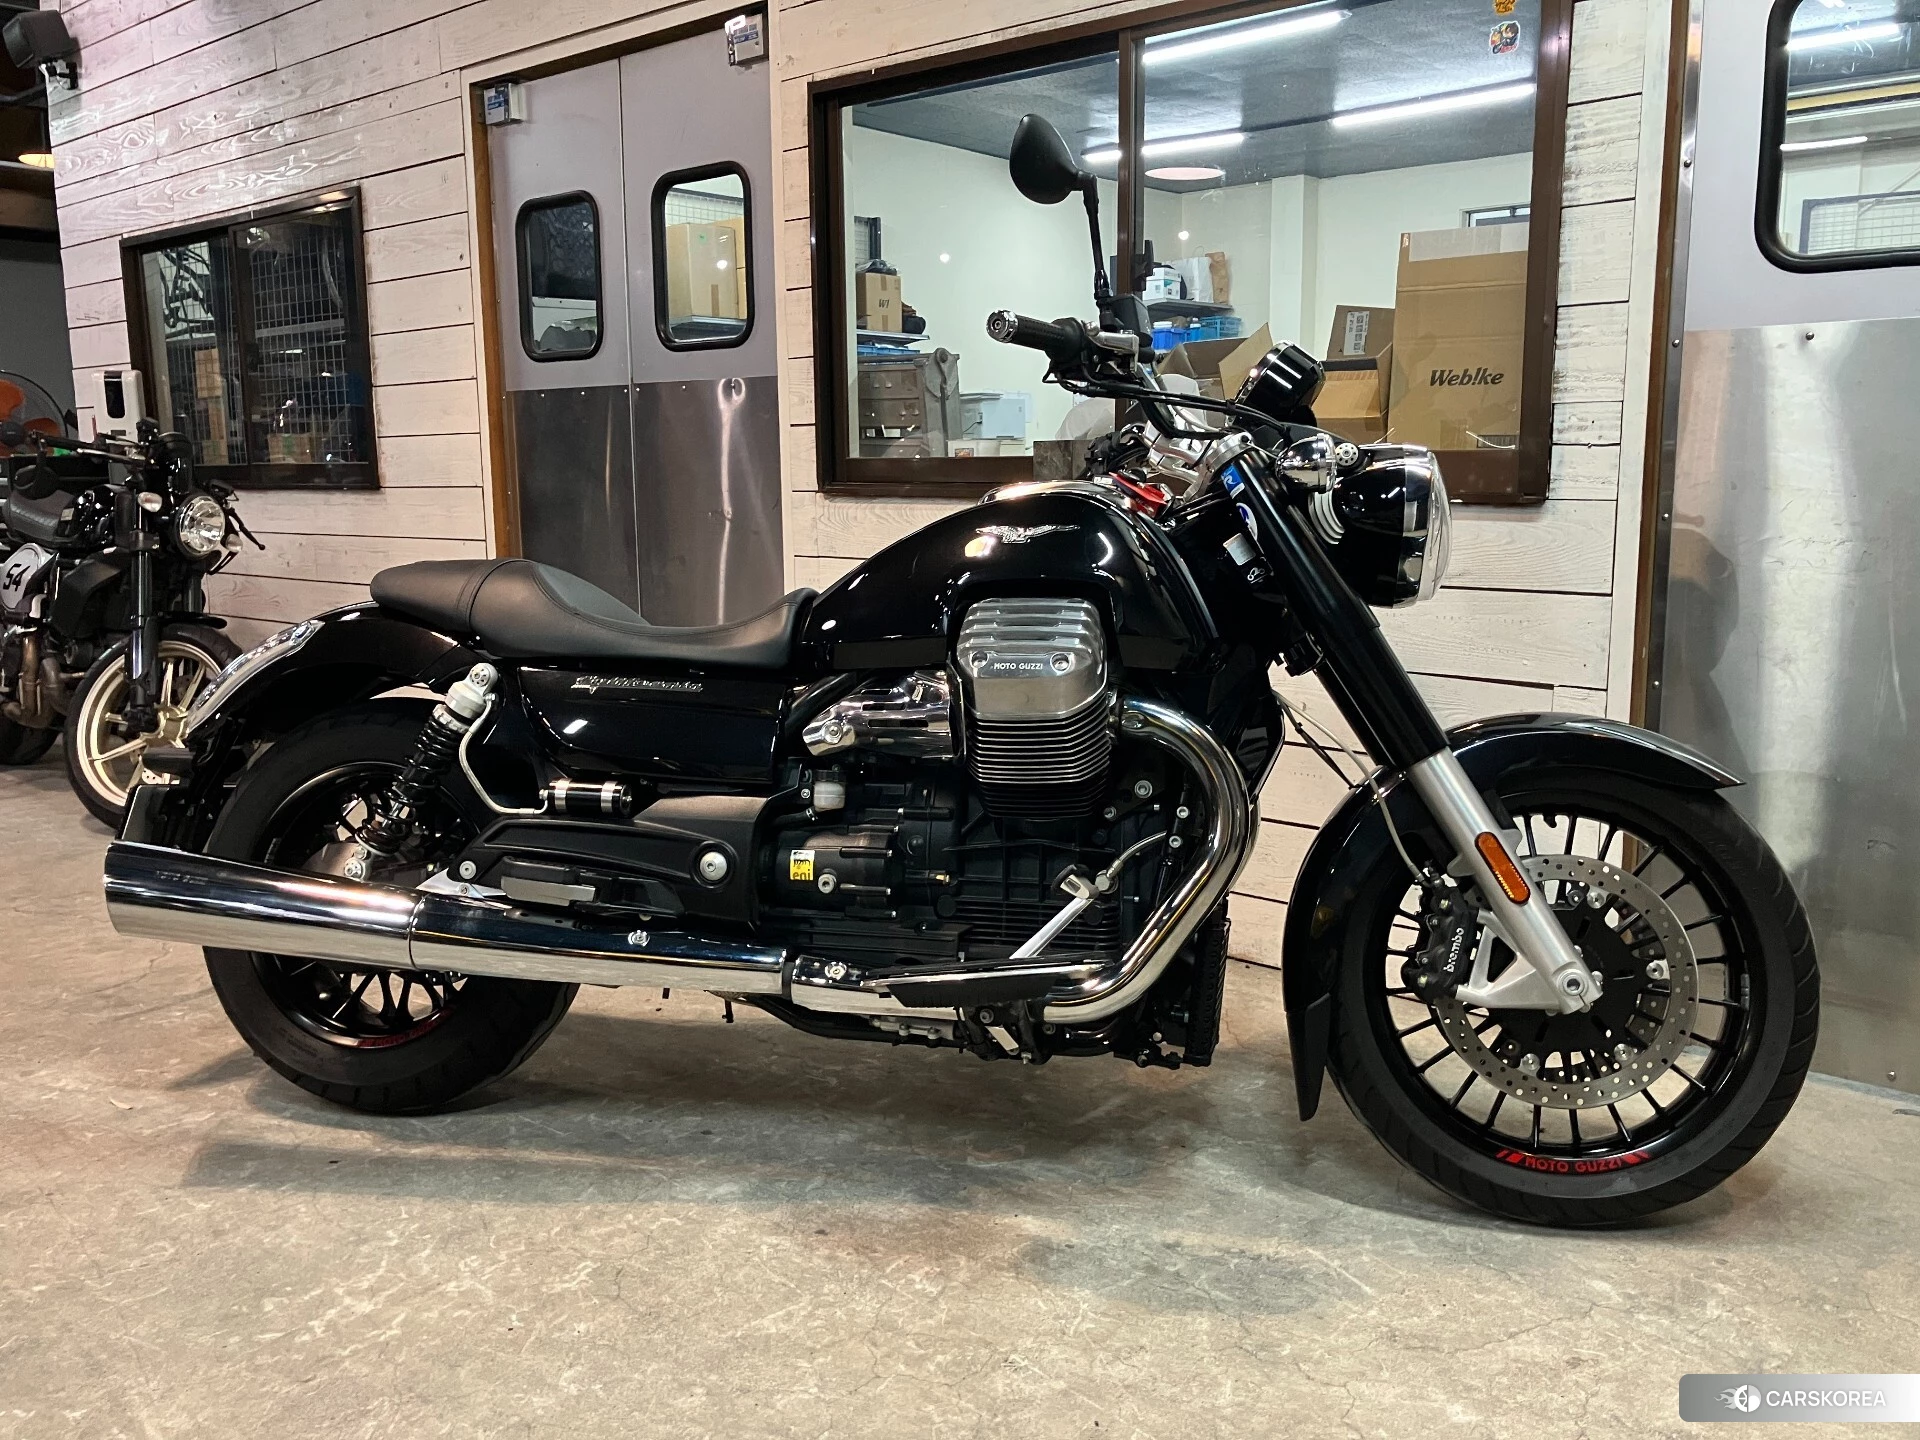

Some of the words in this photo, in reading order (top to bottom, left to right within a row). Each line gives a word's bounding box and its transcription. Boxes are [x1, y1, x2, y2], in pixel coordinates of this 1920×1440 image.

[2, 563, 31, 592] 54
[993, 662, 1017, 670] MOTO
[1018, 662, 1044, 670] GUZZI
[792, 868, 811, 880] eni
[1442, 927, 1465, 973] brembo
[1524, 1156, 1569, 1173] MOTO
[1574, 1158, 1622, 1173] GUZZI
